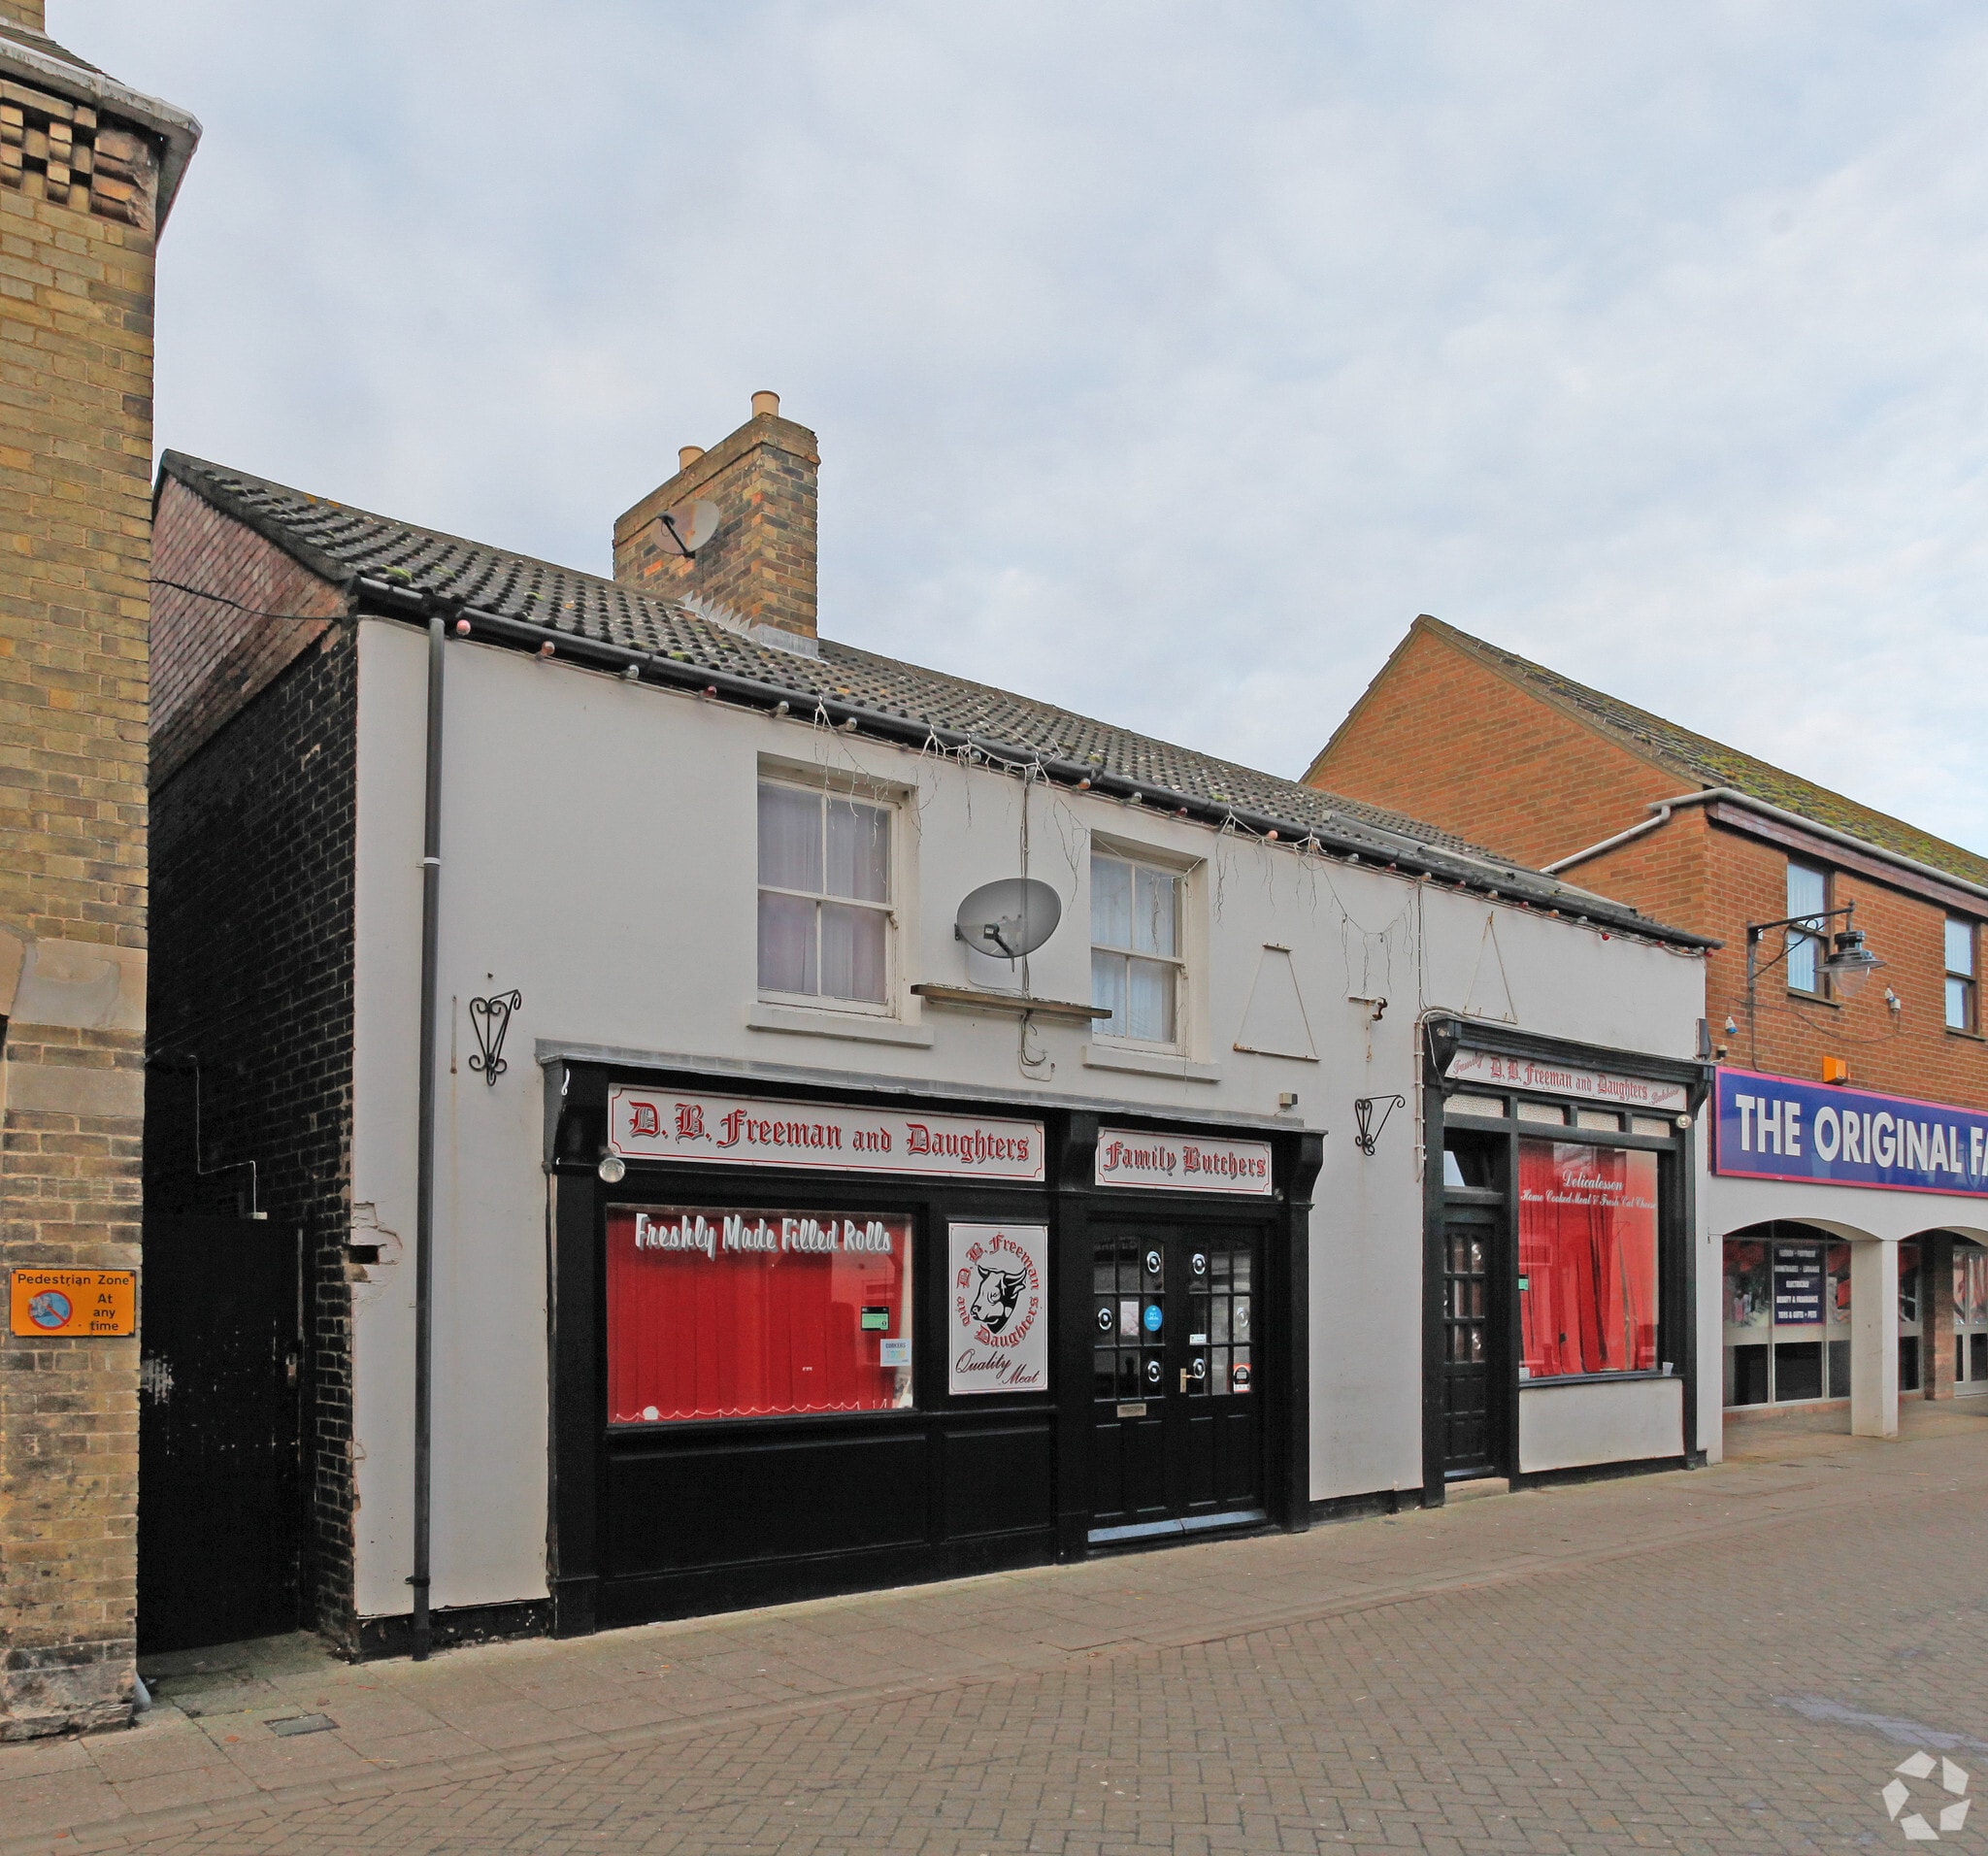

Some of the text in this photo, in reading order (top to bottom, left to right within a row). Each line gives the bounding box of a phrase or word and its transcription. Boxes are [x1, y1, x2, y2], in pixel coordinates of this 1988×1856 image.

[1523, 1062, 1572, 1089] Freeman
[1575, 1077, 1592, 1092] and
[1597, 1073, 1648, 1101] Daughters
[716, 1109, 843, 1150] Freeman
[852, 1127, 892, 1152] and
[906, 1122, 1030, 1164] Daughters
[1736, 1094, 1988, 1177] THE ORIGINAL F
[1103, 1141, 1267, 1180] Family Butchers
[1562, 1169, 1623, 1191] Delicatessen
[635, 1213, 892, 1261] Freshly Made Filled Rolls
[988, 1233, 1042, 1291] Freeman
[17, 1274, 130, 1285] Pedestrian Zone
[93, 1309, 116, 1319] any
[98, 1293, 114, 1304] At
[956, 1296, 972, 1327] and
[90, 1321, 118, 1331] time
[974, 1296, 1040, 1348] Daughters
[955, 1348, 1011, 1379] Quality
[1002, 1364, 1041, 1384] Meat
